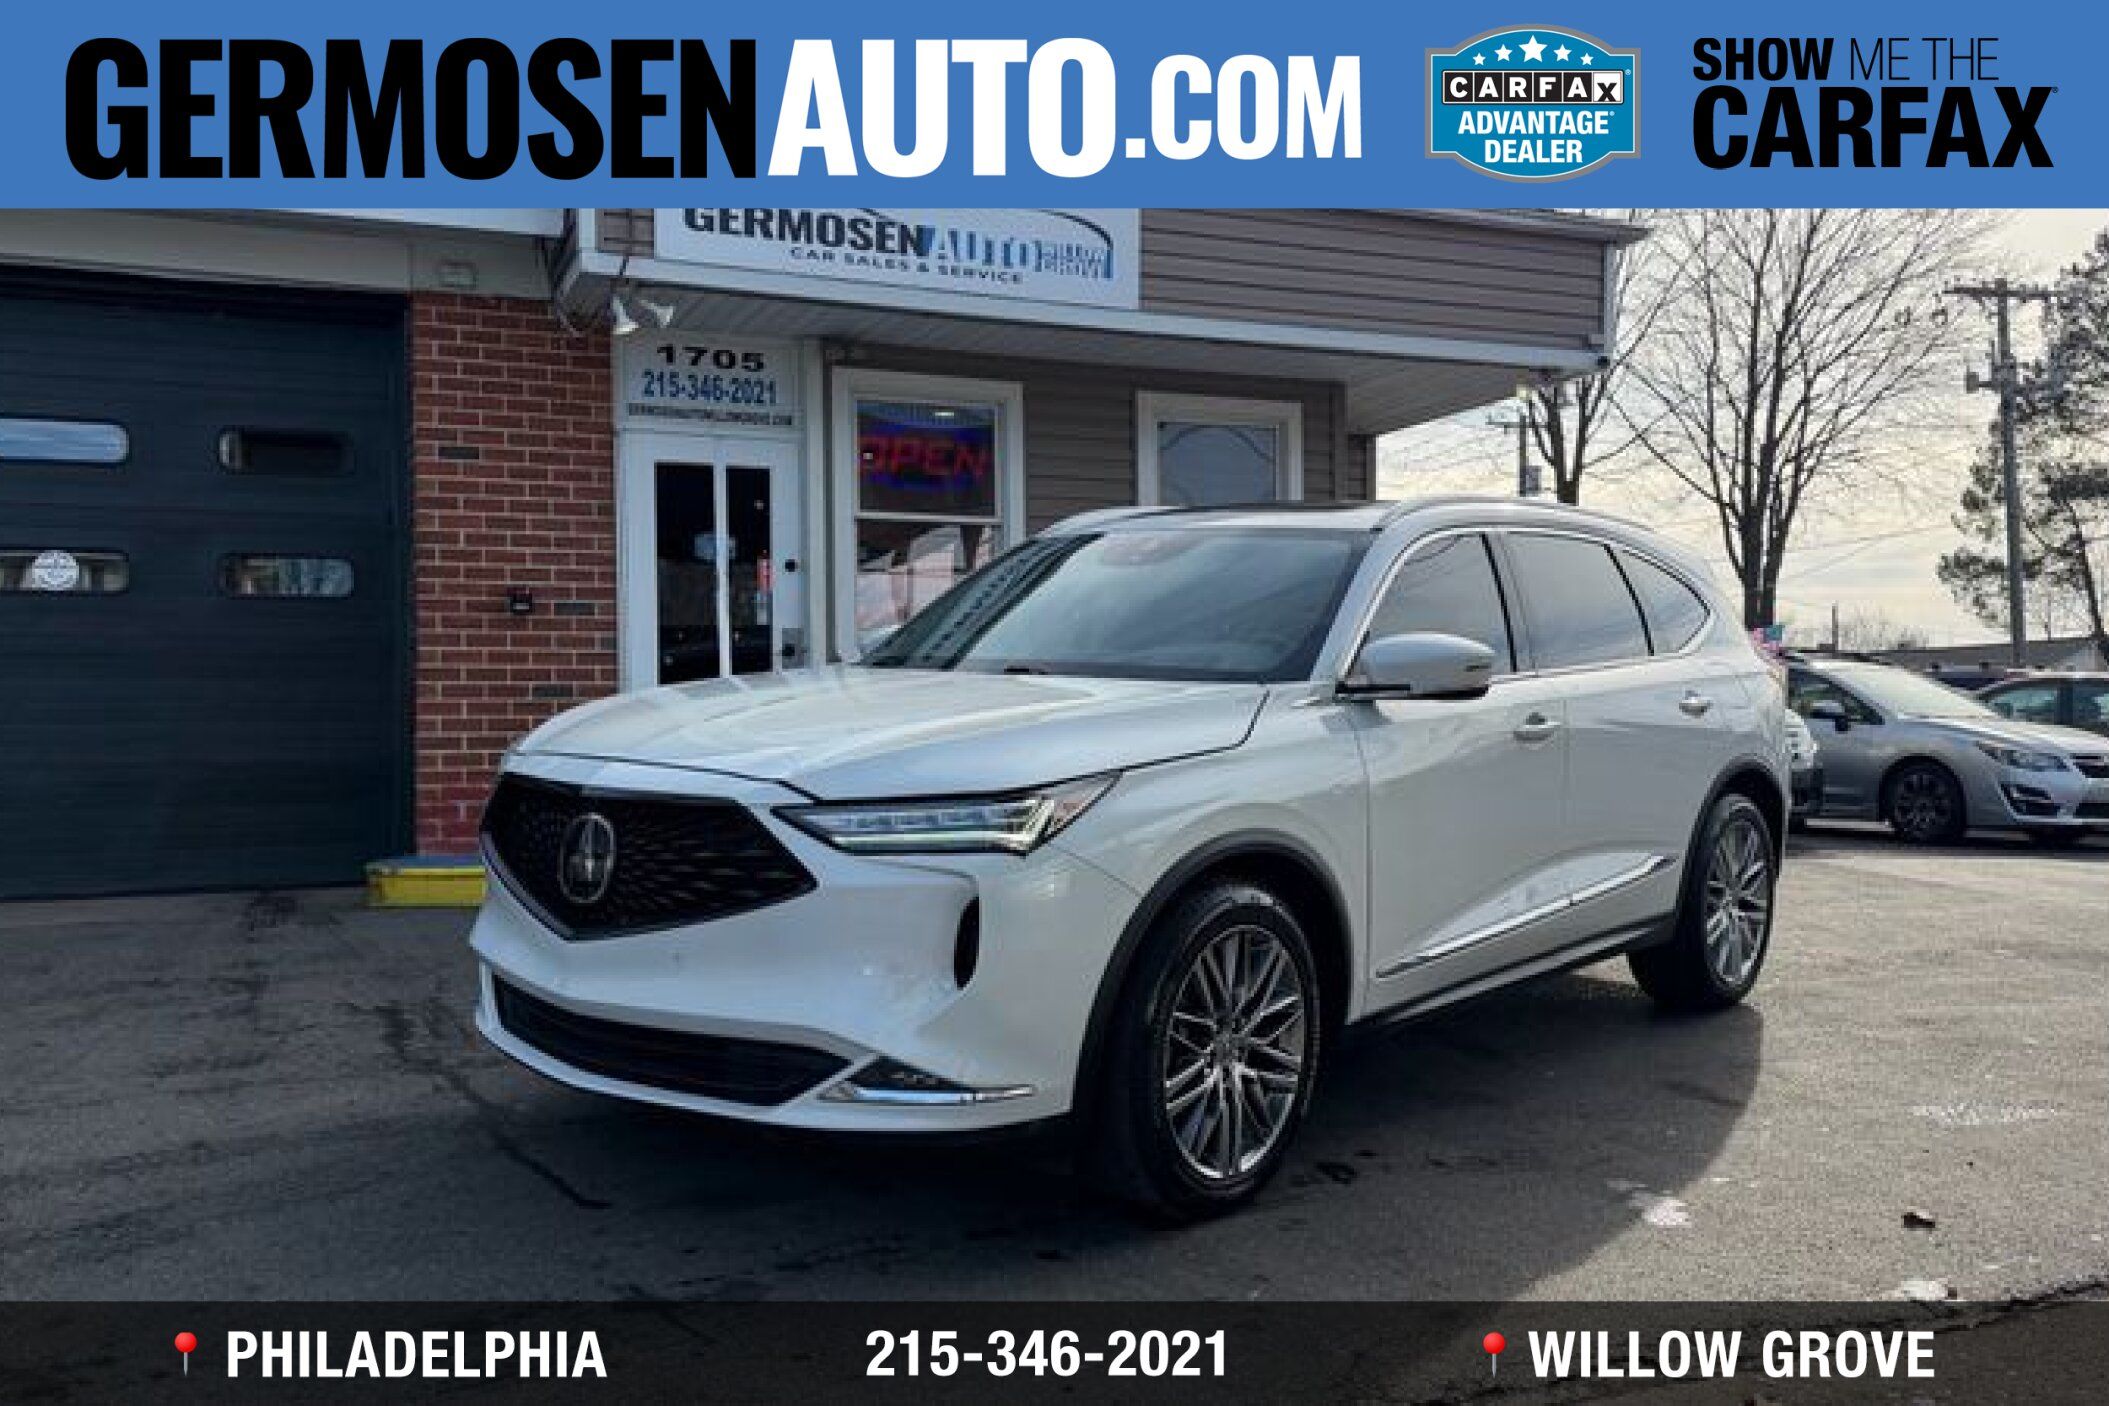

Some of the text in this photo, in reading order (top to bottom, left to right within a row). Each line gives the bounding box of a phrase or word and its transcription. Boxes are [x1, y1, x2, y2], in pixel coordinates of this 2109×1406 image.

[790, 246, 836, 261] CAR
[657, 345, 765, 372] 1705
[642, 369, 778, 406] 215-346-2021
[858, 436, 989, 482] OPEN
